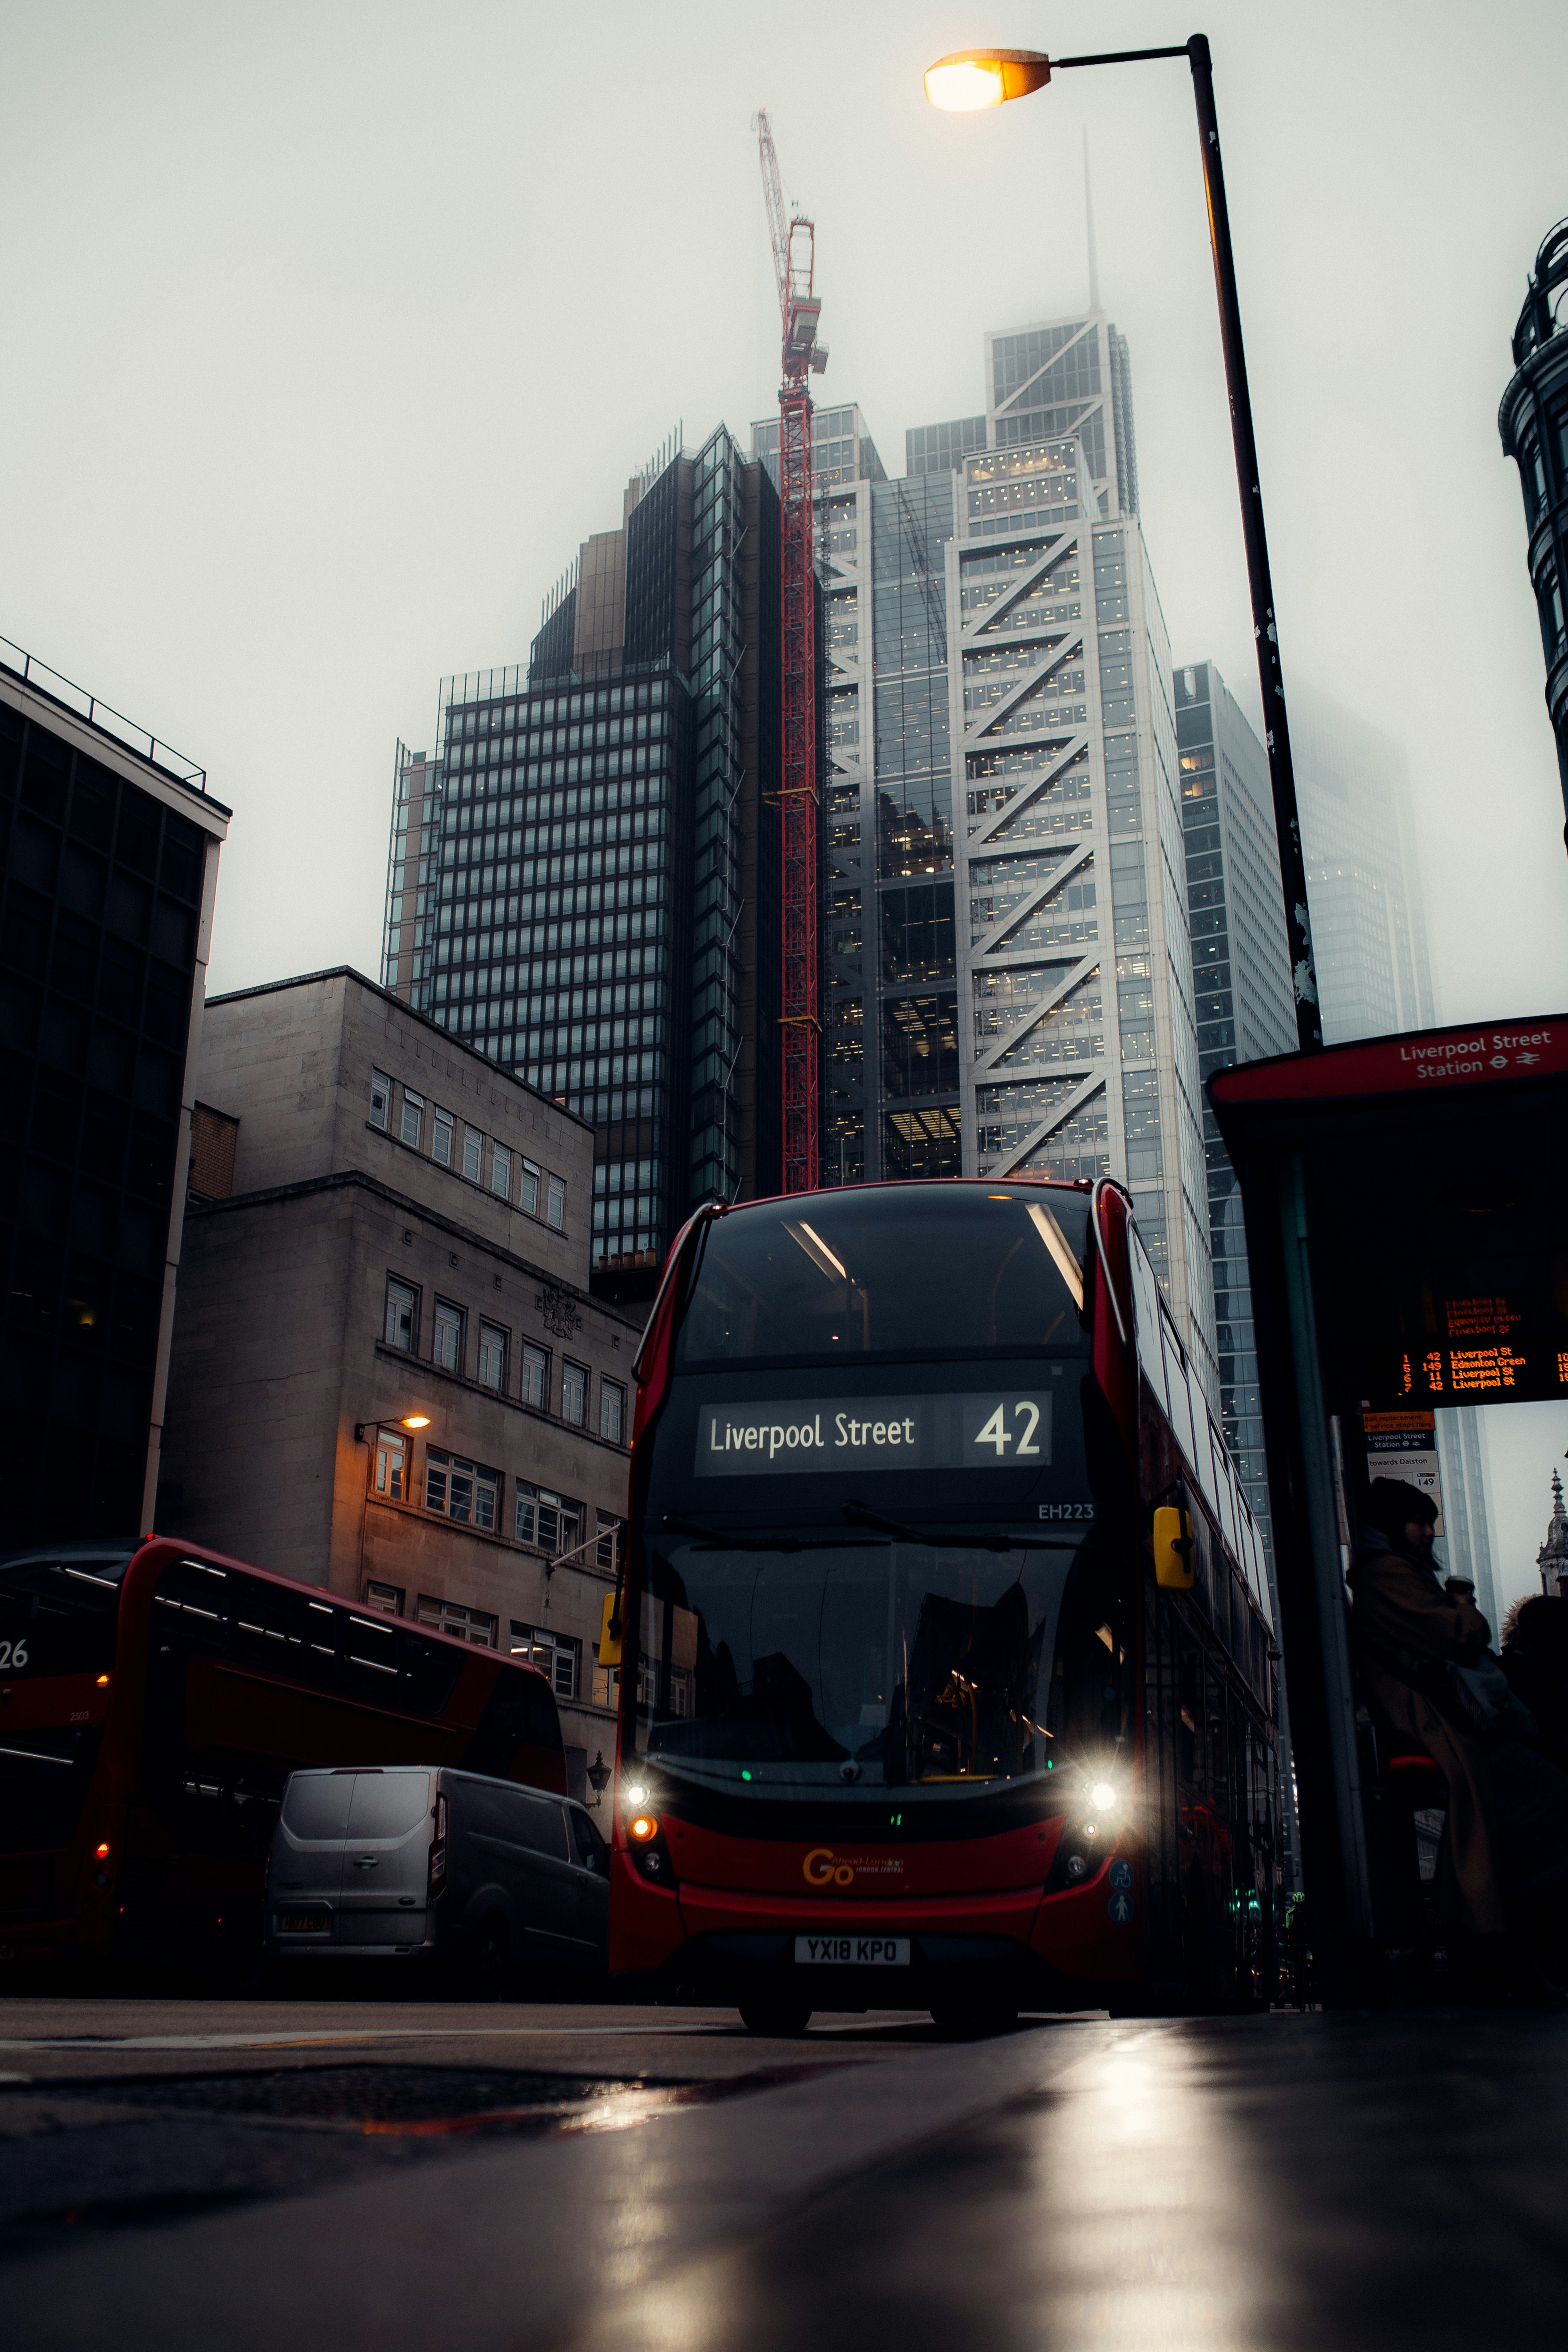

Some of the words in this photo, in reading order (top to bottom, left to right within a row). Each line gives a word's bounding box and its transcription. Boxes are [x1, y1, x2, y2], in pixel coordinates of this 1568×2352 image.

[1400, 1037, 1487, 1061] Liverpool
[1493, 1031, 1552, 1049] Street
[1417, 1061, 1483, 1078] Station
[1427, 1352, 1441, 1360] 42
[1450, 1347, 1498, 1359] Liverpool
[1500, 1346, 1512, 1355] St
[1402, 1363, 1410, 1372] 5
[1422, 1362, 1441, 1371] 149
[1451, 1359, 1495, 1369] Edmonton
[1497, 1357, 1526, 1366] Green
[1404, 1374, 1411, 1382] 6
[1429, 1371, 1441, 1380] 11
[1452, 1367, 1501, 1379] Liverpool
[1502, 1366, 1514, 1375] St
[1429, 1381, 1443, 1390] 42
[1453, 1377, 1501, 1389] Liverpool
[1503, 1377, 1515, 1386] St
[711, 1414, 824, 1459] Liverpool
[834, 1413, 915, 1446] Street
[974, 1401, 1040, 1455] 42
[1038, 1504, 1094, 1519] EH223
[0, 1639, 29, 1669] 26
[70, 1711, 89, 1721] 2503
[803, 1848, 854, 1886] Go
[808, 1940, 851, 1960] YX18
[857, 1941, 896, 1961] KPO
